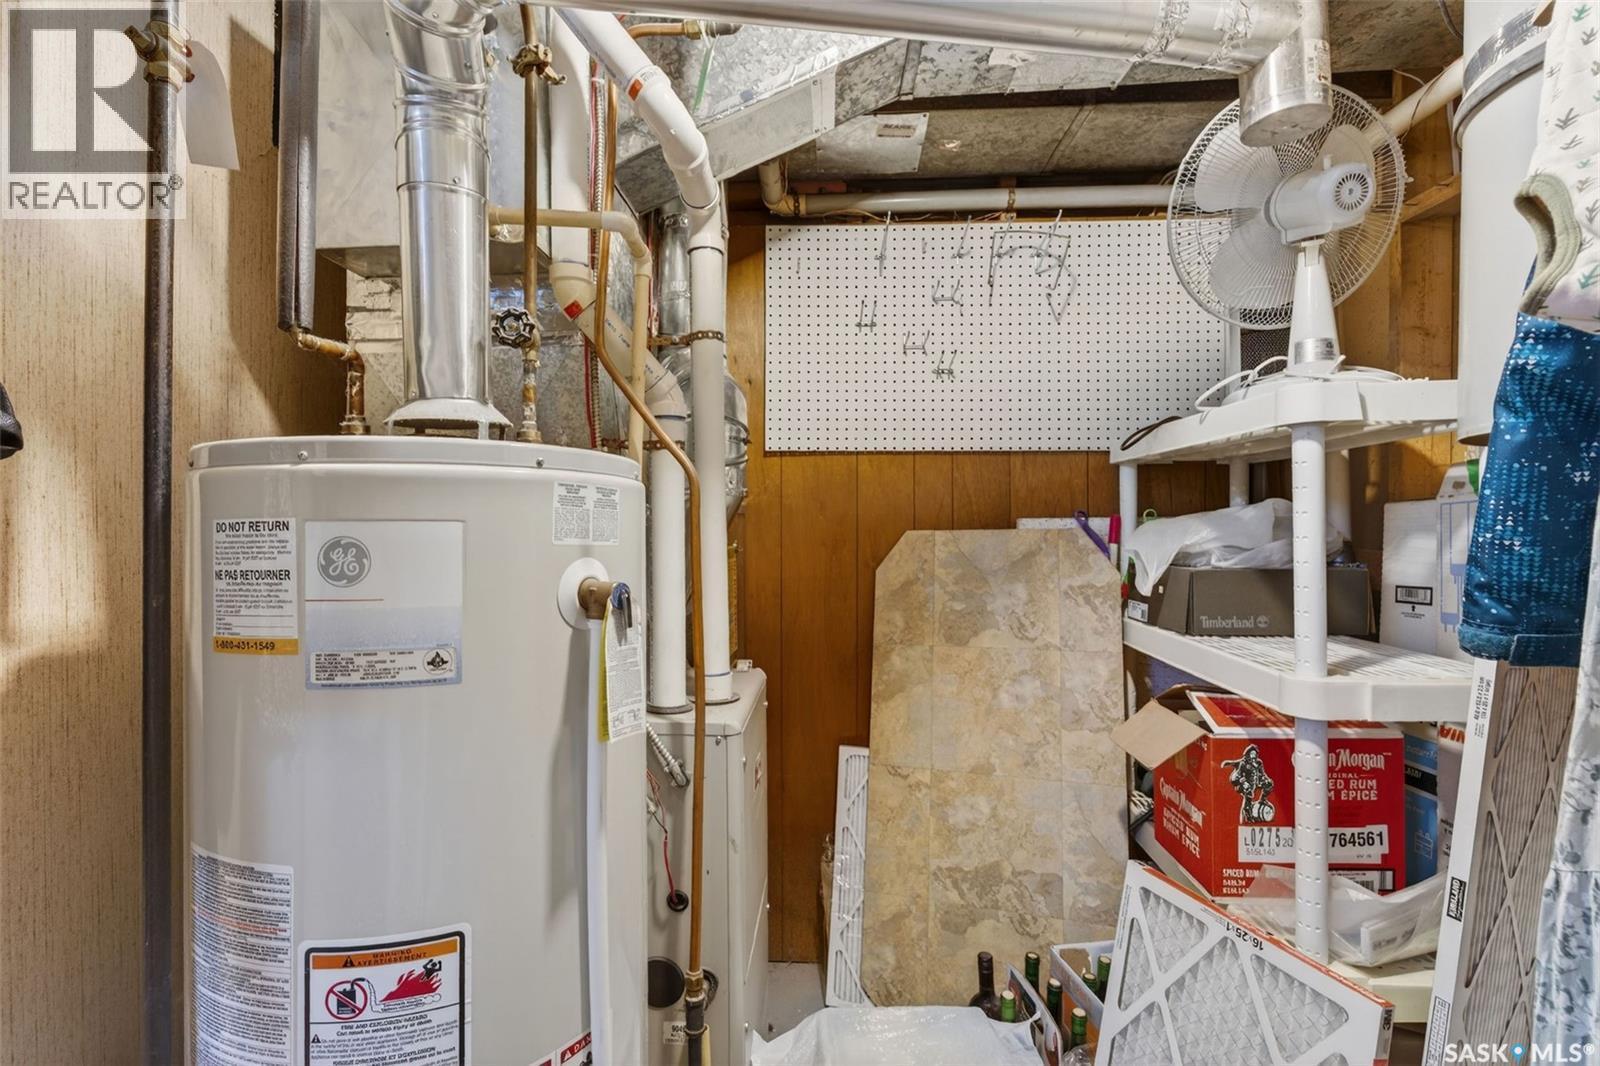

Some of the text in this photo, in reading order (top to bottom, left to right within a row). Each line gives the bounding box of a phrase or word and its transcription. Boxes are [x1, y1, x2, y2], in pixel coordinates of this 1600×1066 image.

[216, 520, 289, 533] DO NOT RETURN
[215, 569, 291, 580] NE PAS RETOURNER
[1200, 615, 1254, 628] Timberland
[1336, 749, 1385, 771] Morgan
[1349, 779, 1377, 790] RUM
[1329, 831, 1384, 848] 764561
[1223, 869, 1244, 878] SPICED
